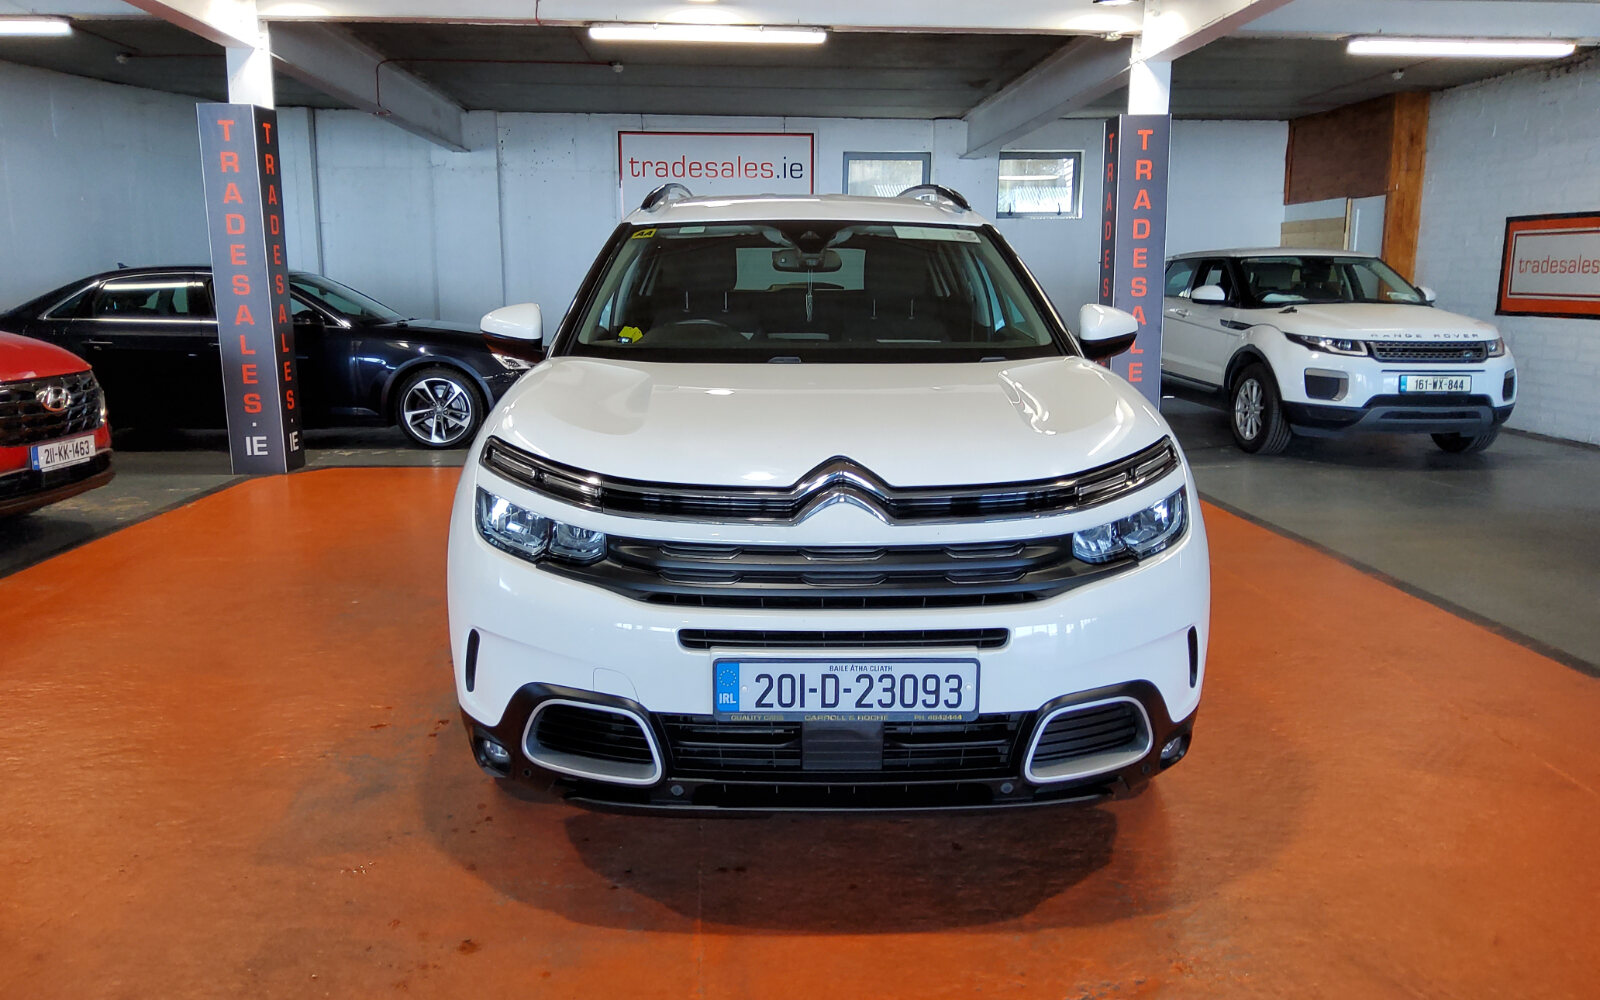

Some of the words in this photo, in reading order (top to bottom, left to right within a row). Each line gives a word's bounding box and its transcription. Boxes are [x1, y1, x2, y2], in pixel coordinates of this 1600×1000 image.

[628, 154, 804, 179] tradesales.ie
[1415, 379, 1465, 391] 161-WX-844
[44, 440, 90, 465] 211-KK-1463
[719, 693, 737, 705] IRL
[754, 673, 964, 709] 201-D-23093
